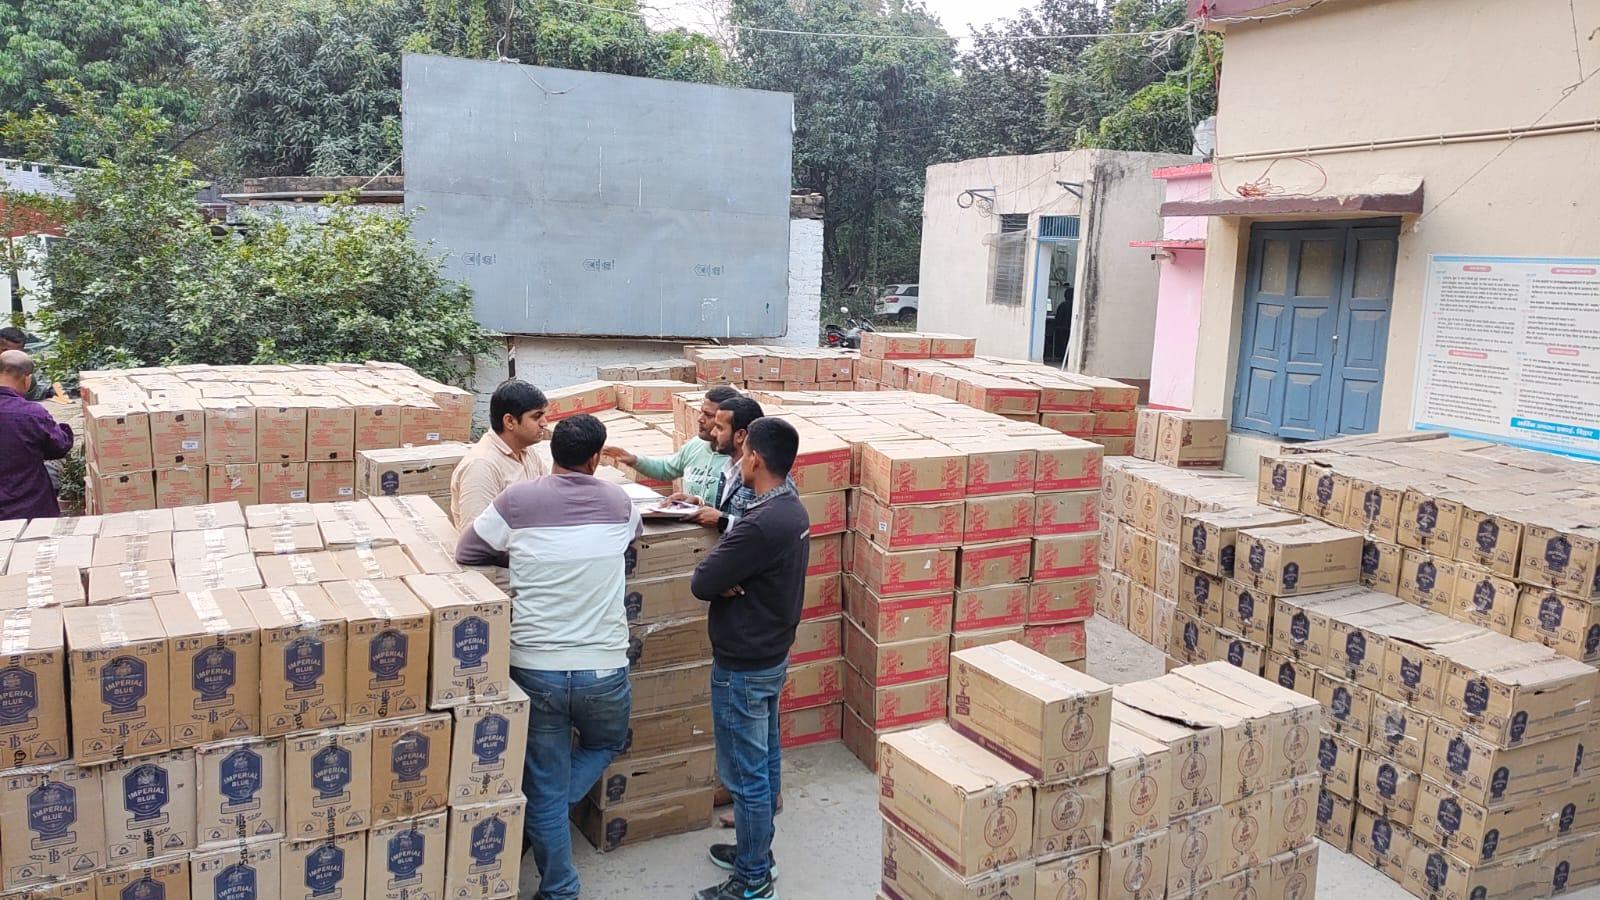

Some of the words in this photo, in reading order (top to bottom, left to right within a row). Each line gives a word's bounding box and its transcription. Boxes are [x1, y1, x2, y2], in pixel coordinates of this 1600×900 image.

[455, 638, 486, 648] IMPERIAL
[463, 644, 479, 652] BLUE
[372, 650, 404, 661] IMPERIAL
[287, 658, 321, 670] IMPERIAL
[195, 668, 231, 680] IMPERIAL
[204, 675, 223, 683] BLUE
[105, 679, 143, 692] IMPERIAL
[114, 686, 133, 695] BLUE
[2, 698, 24, 706] BLUE
[476, 734, 505, 745] IMPERIAL
[394, 752, 426, 763] IMPERIAL
[223, 771, 258, 784] IMPERIAL
[314, 767, 348, 779] IMPERIAL
[127, 786, 165, 800] IMPERIAL
[137, 795, 155, 803] BLUE
[32, 805, 72, 818] IMPERIAL
[42, 813, 64, 821] BLUE
[390, 850, 421, 862] IMPERIAL
[397, 857, 414, 865] BLUE
[307, 864, 341, 878] IMPERIAL
[315, 871, 333, 880] BLUE
[218, 885, 252, 898] IMPERIAL
